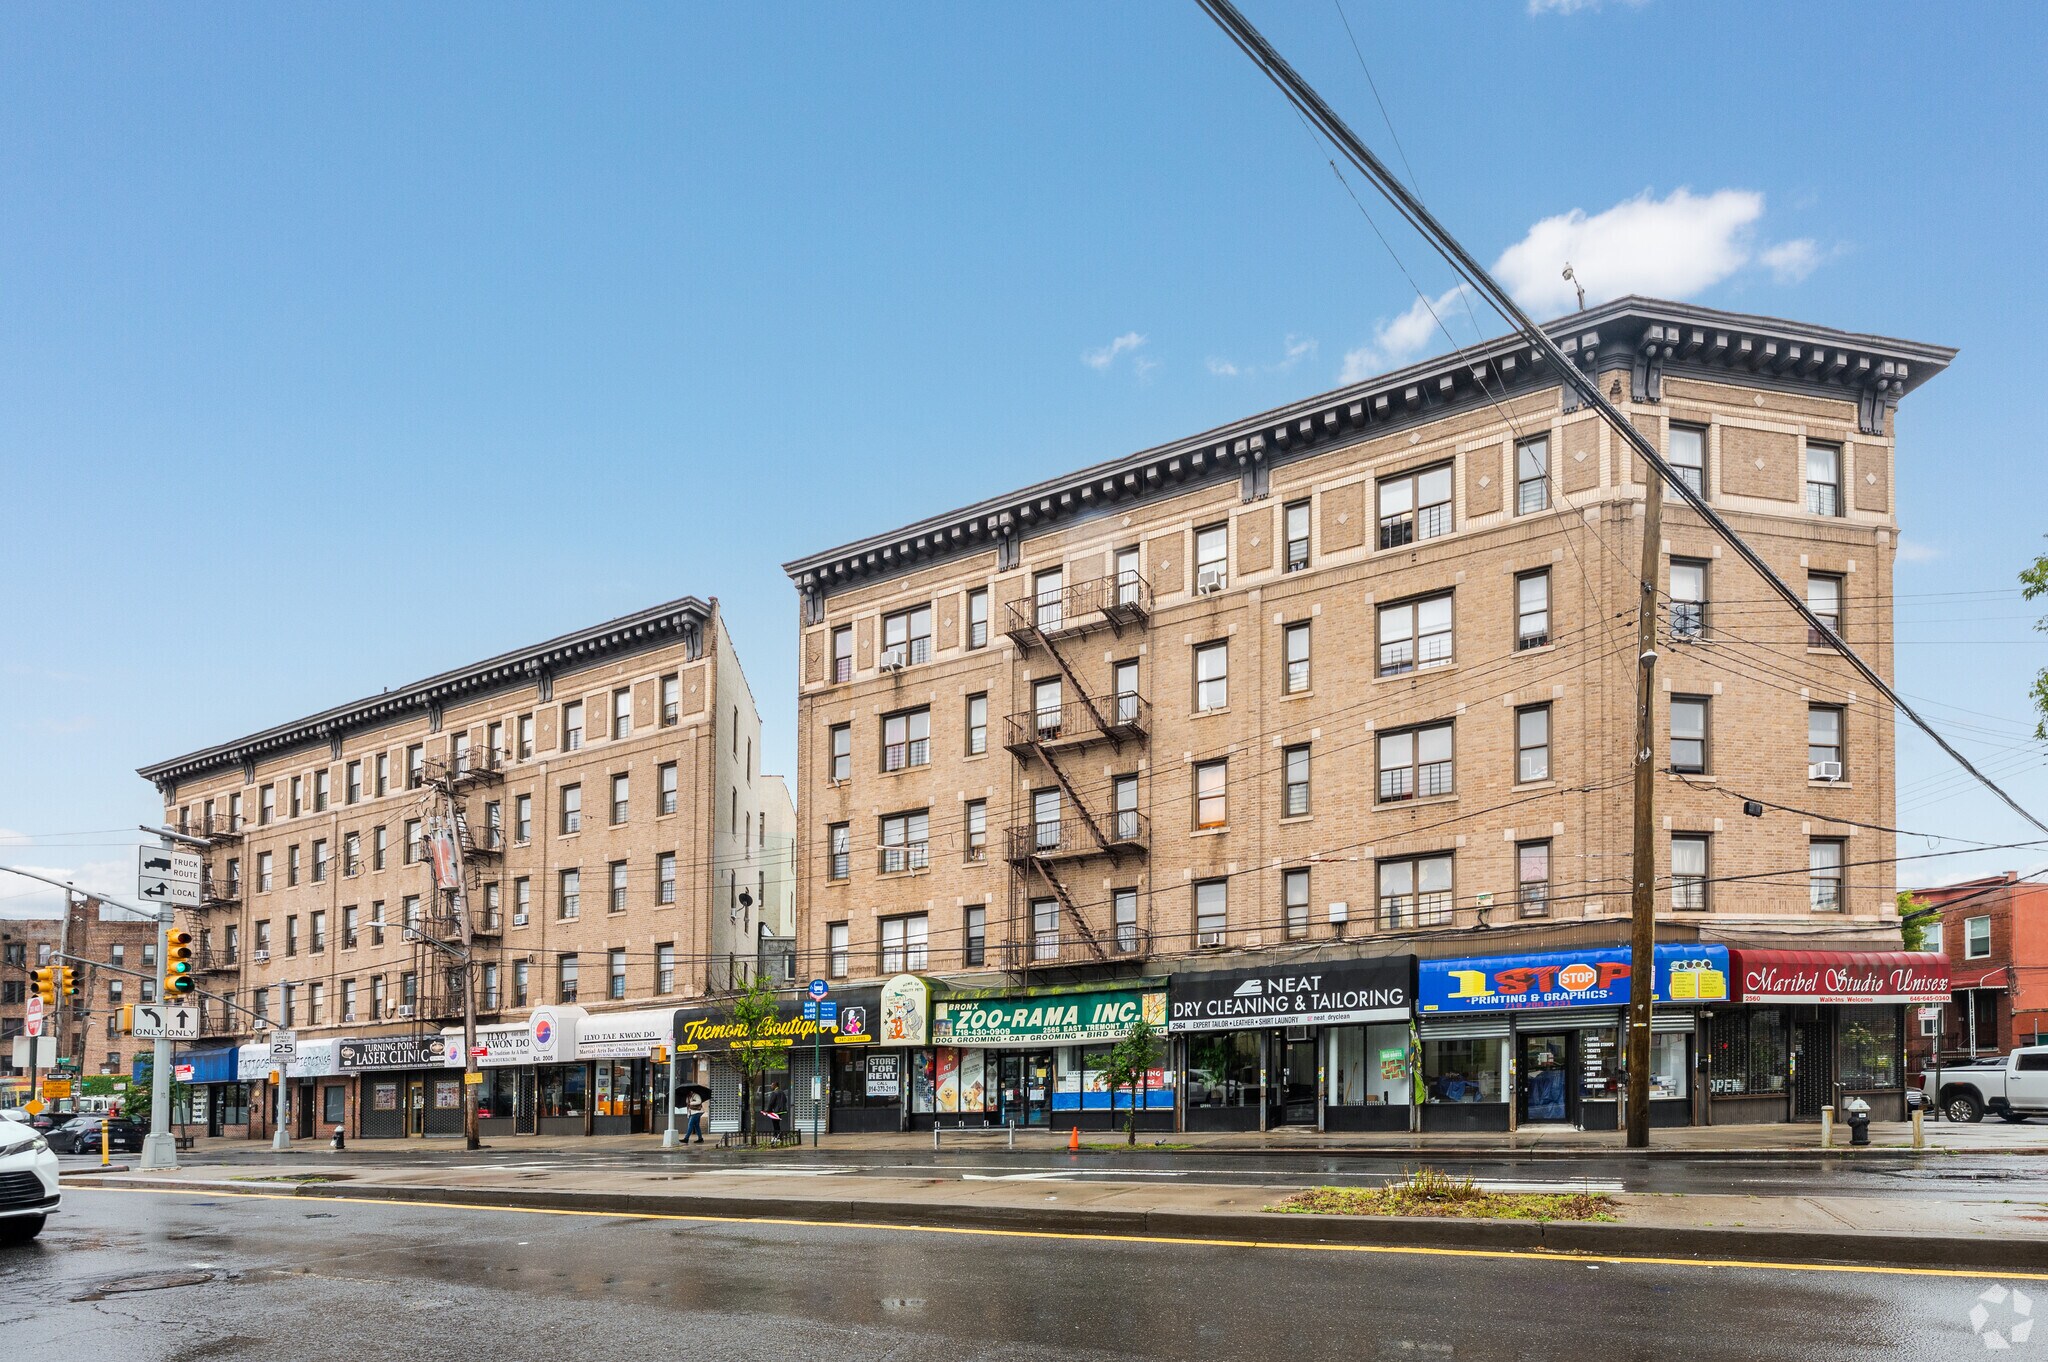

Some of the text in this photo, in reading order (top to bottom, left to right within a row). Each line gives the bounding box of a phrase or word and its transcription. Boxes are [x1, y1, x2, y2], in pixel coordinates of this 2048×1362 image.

[174, 859, 198, 868] TRUCK
[174, 870, 198, 879] ROUTE
[172, 889, 196, 898] LOCAL
[1561, 972, 1593, 983] STOP
[1746, 967, 1819, 992] Maribel
[1825, 968, 1884, 992] Studio
[1890, 968, 1948, 991] Unisex
[1268, 976, 1321, 994] NEAT
[1448, 970, 1495, 998] 1
[1471, 995, 1526, 1004] PRINTING
[1544, 990, 1608, 1001] GRAPHICS
[1174, 988, 1403, 1018] DRY CLEANING & TAILORING
[956, 1002, 1141, 1029] ZOO-RAMA INC.
[487, 1032, 507, 1040] ILYO
[1087, 1030, 1109, 1038] BIRD
[274, 1044, 293, 1053] 25
[364, 1042, 419, 1052] TURNING POINT
[486, 1040, 512, 1048] KWON
[516, 1039, 529, 1047] DO
[356, 1051, 387, 1065] LASER
[389, 1049, 429, 1064] CLINIC
